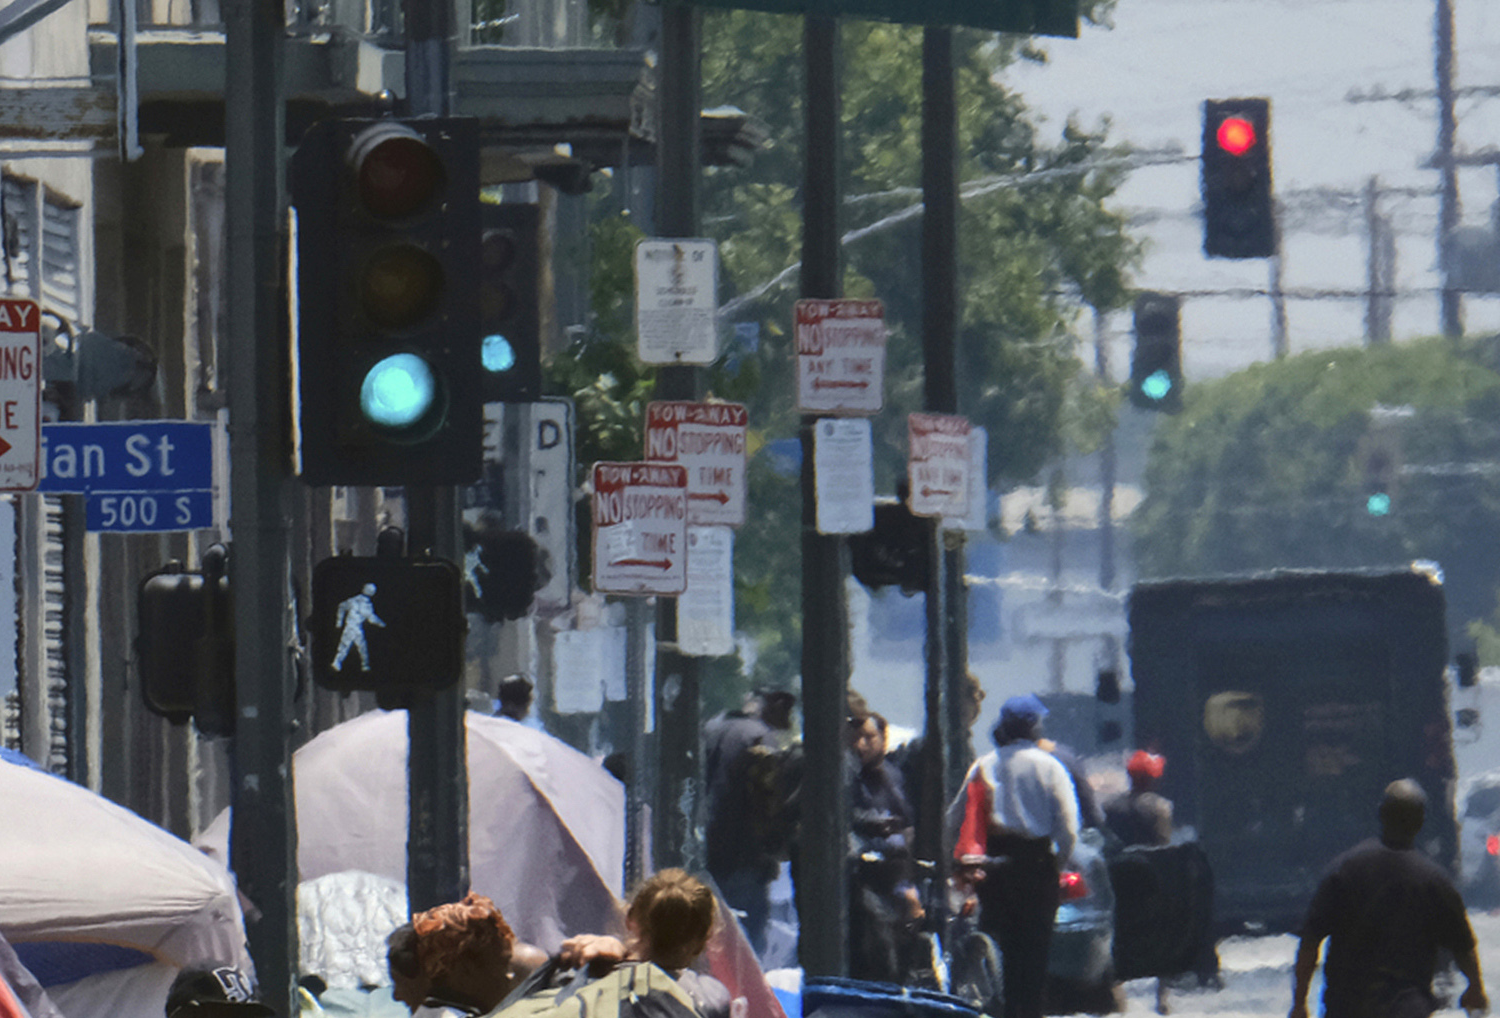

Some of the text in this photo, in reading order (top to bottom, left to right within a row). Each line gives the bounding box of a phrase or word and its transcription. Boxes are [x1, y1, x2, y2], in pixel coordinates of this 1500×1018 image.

[798, 323, 821, 352] NO
[651, 405, 744, 422] TOW-AWAY
[125, 433, 175, 477] St
[650, 427, 743, 458] NO STOPPING
[700, 467, 733, 486] TIME
[101, 496, 191, 527] 500 S
[596, 491, 684, 523] NO STOPPING
[641, 532, 676, 554] TIME
